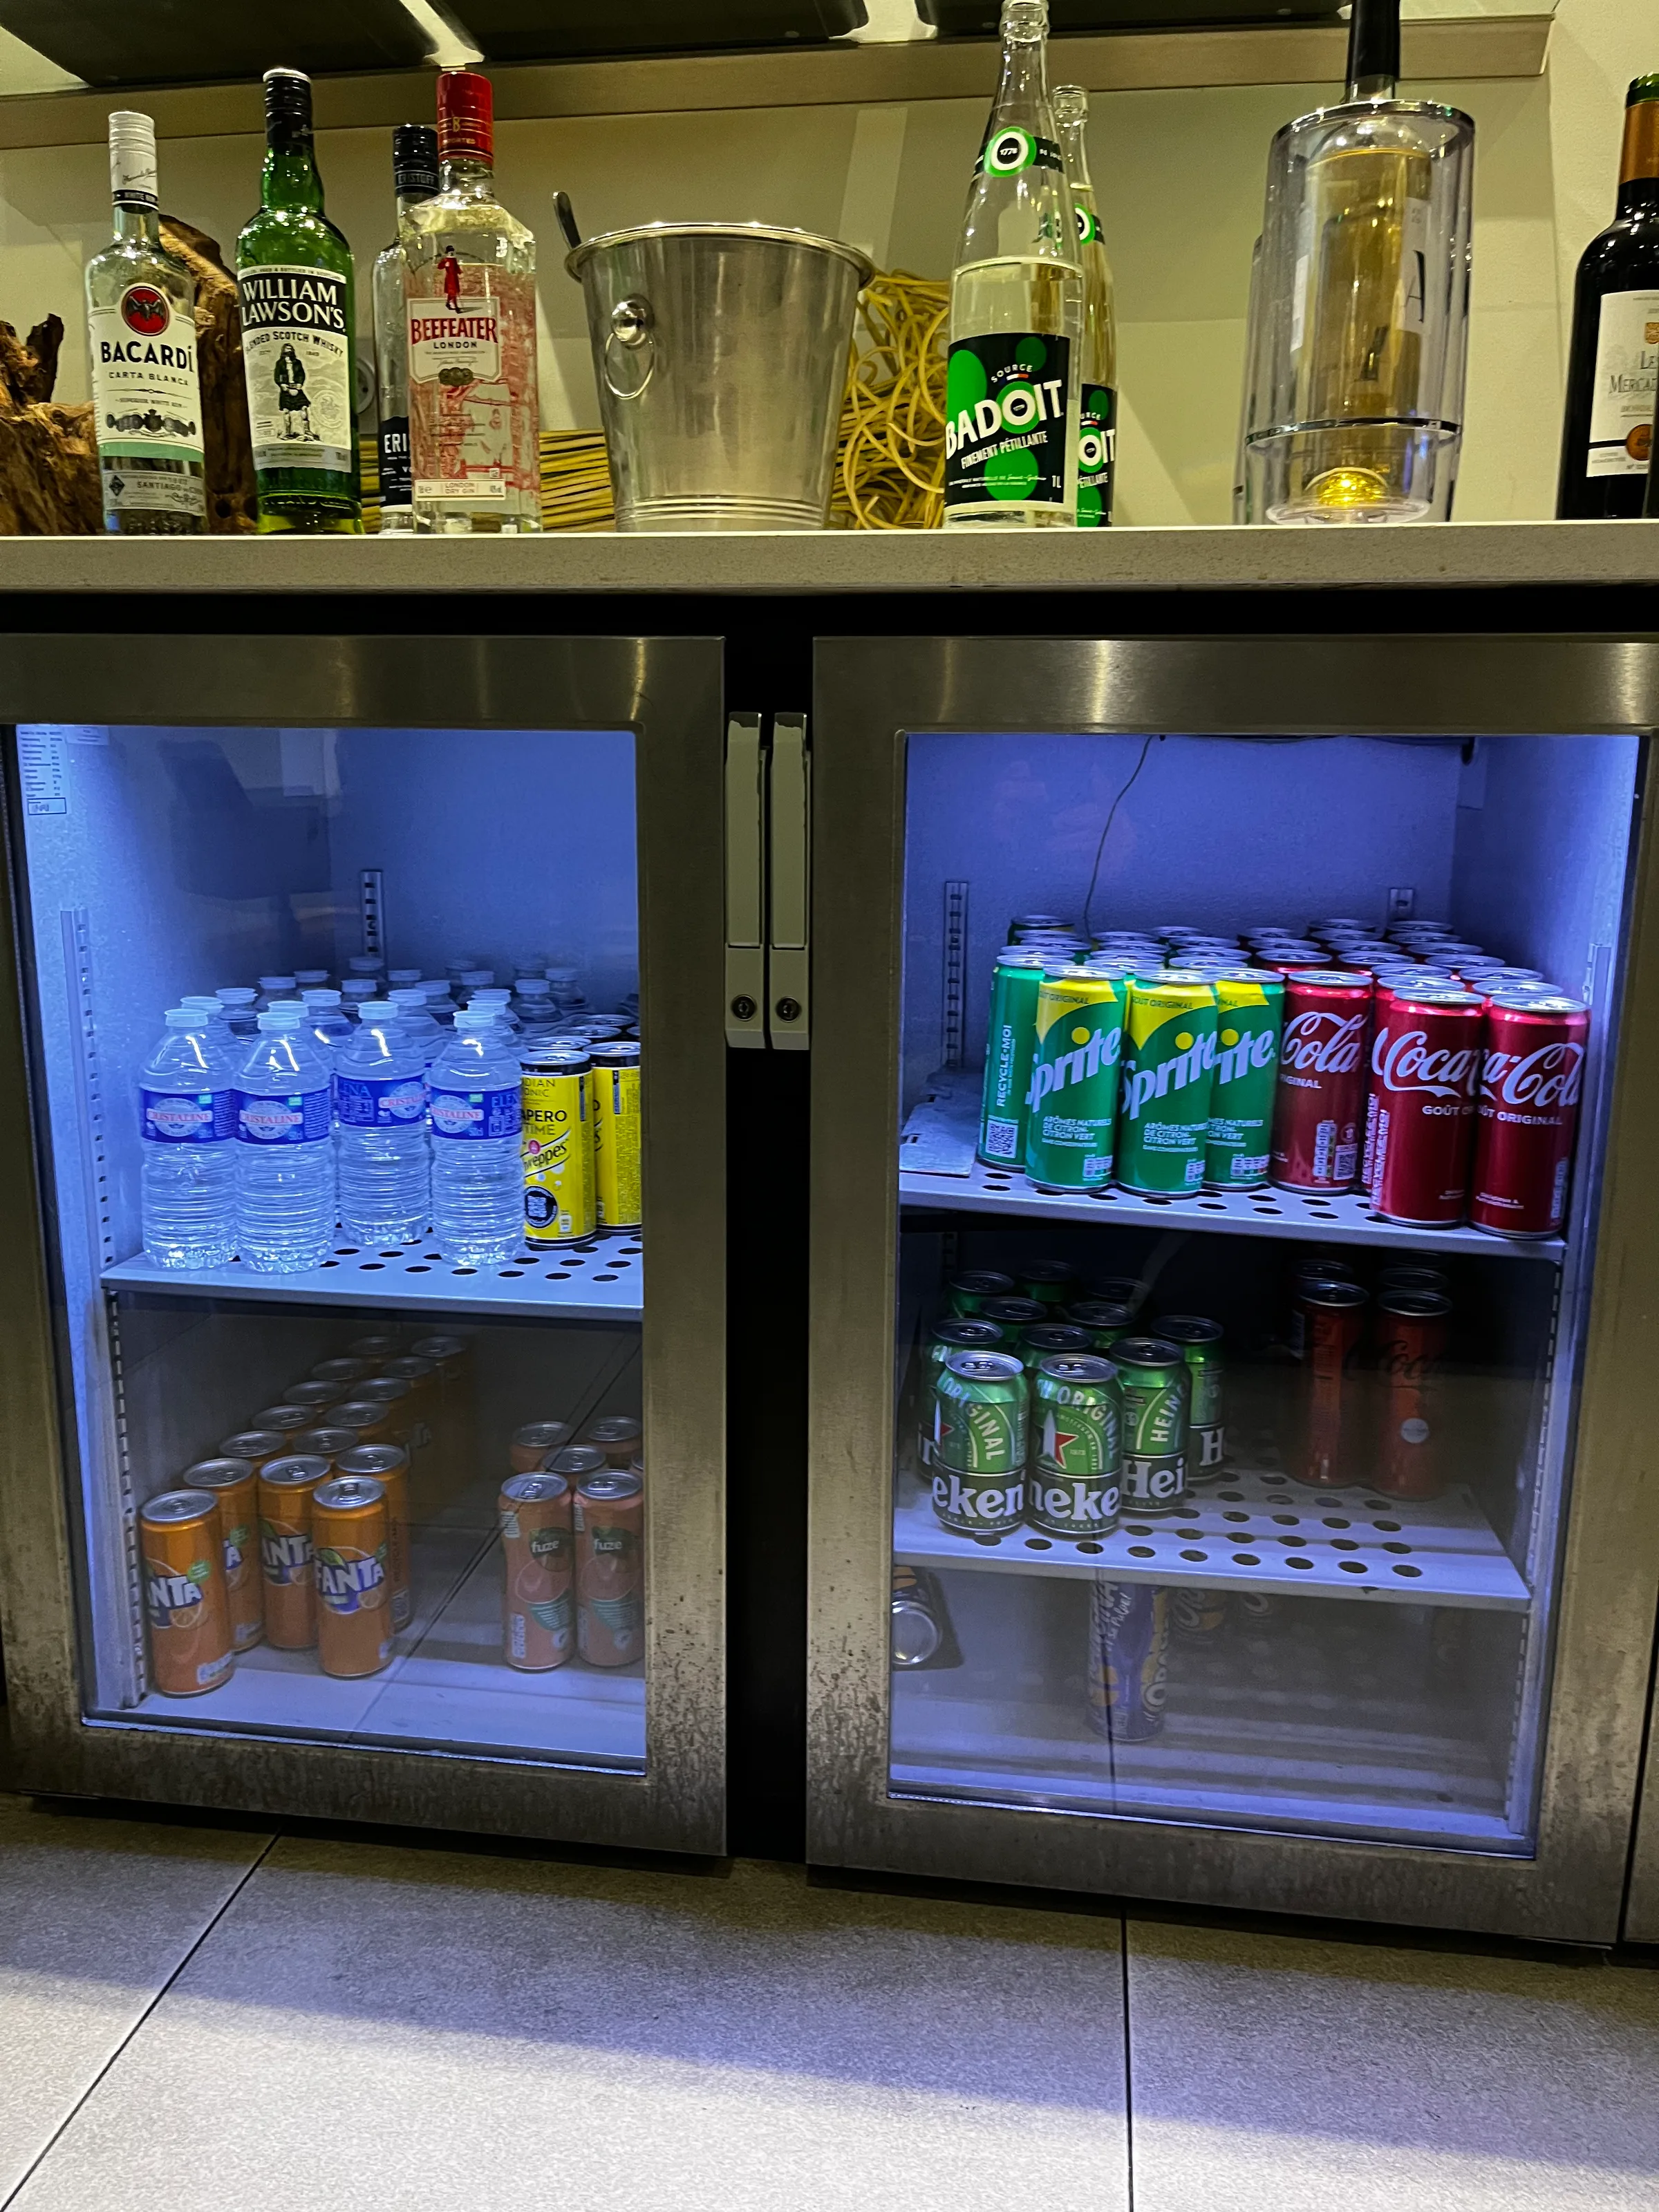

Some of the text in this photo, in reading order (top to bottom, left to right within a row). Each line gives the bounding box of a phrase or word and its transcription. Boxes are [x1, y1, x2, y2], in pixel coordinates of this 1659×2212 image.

[243, 279, 337, 306] WILLIAM
[242, 301, 346, 330] LAWSON'S
[272, 331, 309, 343] SCOTCH
[411, 317, 498, 345] BEEFEATER
[433, 341, 478, 349] LONDON
[149, 373, 188, 386] BLANCA
[991, 364, 1033, 383] SOURCE
[946, 379, 1062, 460] BADOIT
[961, 444, 998, 469] FINEMENT
[1051, 476, 1062, 488] 1L
[1051, 993, 1090, 1004] ORIGINAL
[1149, 1000, 1193, 1009] ORIGINAL
[996, 1024, 1013, 1107] RECYCLE-MOI
[1383, 1031, 1481, 1098] Coca
[148, 1111, 209, 1122] CRISTALINE
[1422, 1105, 1461, 1116] GOÛT
[1042, 1115, 1077, 1125] ARÔMES
[1497, 1111, 1563, 1125] ORIGINAL
[1042, 1130, 1074, 1139] CITRON
[1144, 1129, 1156, 1137] DE
[1144, 1136, 1177, 1145] CITRON
[942, 1376, 1006, 1461] ORIGINAL
[531, 1539, 559, 1554] fuze
[594, 1537, 622, 1551] fuze
